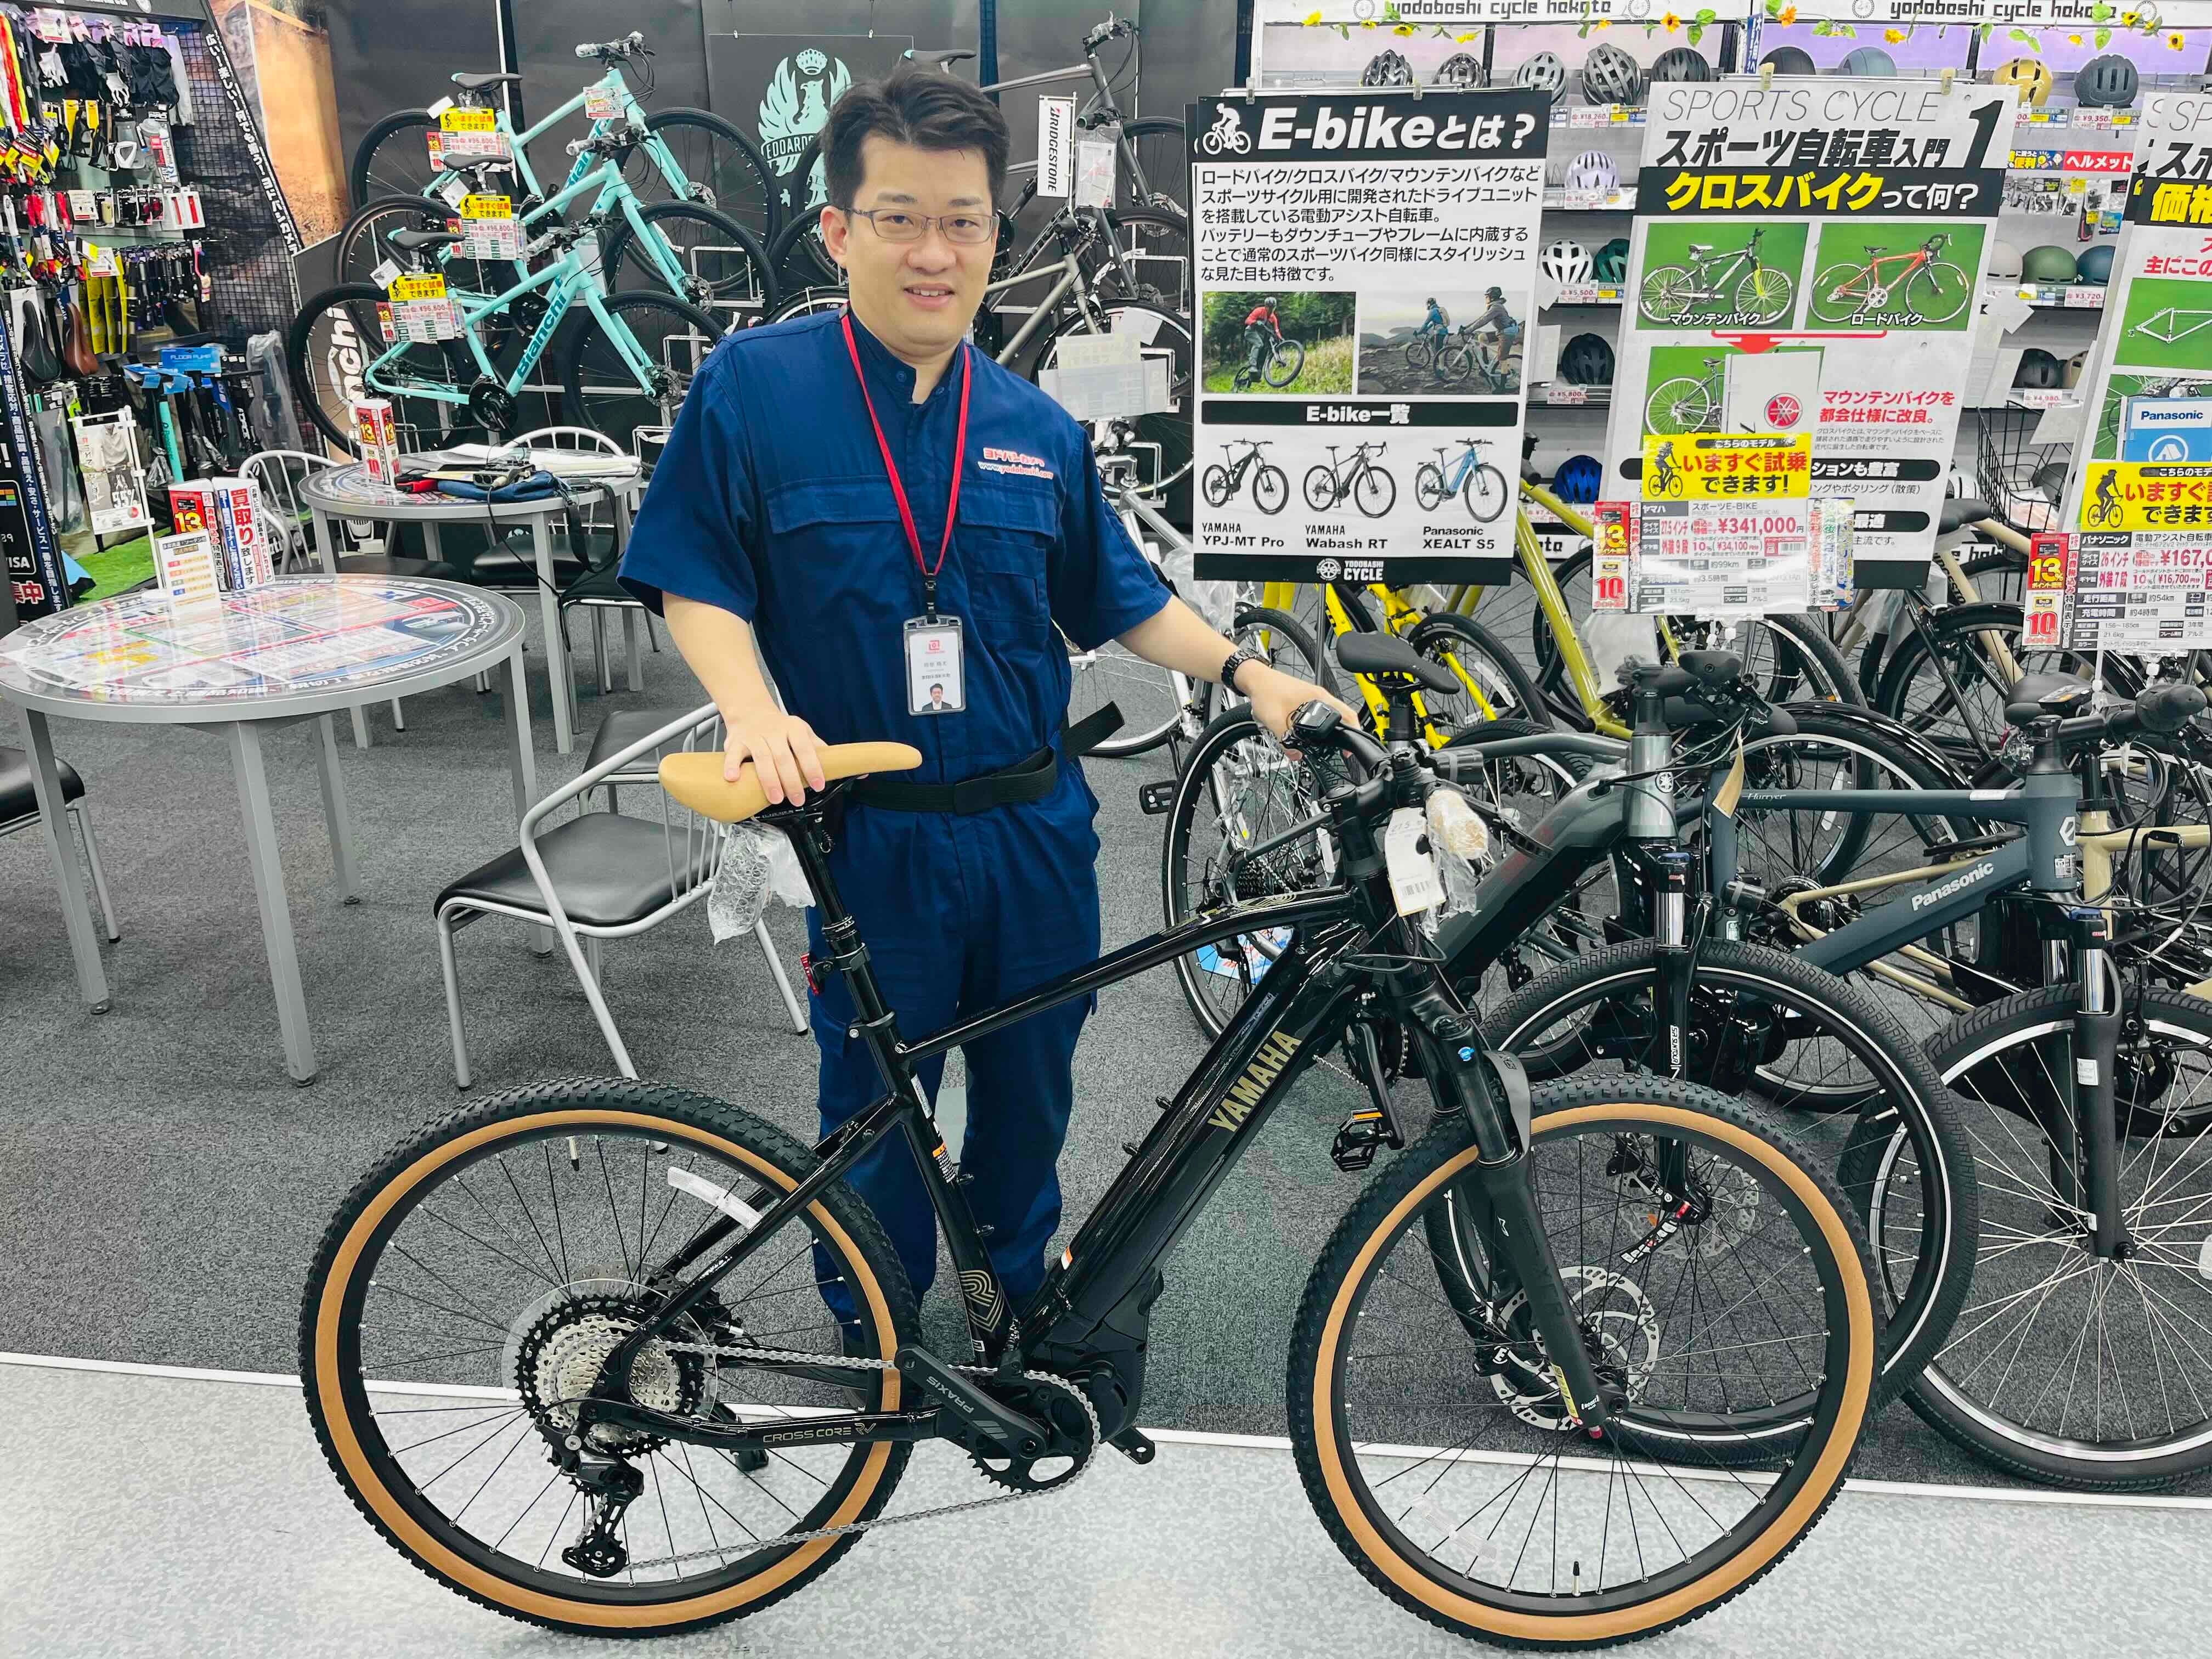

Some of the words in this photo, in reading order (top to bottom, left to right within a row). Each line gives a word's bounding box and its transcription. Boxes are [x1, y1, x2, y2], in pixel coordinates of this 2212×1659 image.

[1490, 1, 1537, 19] cycle
[1891, 0, 1984, 21] yodobashi
[1993, 3, 2042, 23] cycle
[1662, 89, 1811, 122] SPORTS
[1822, 90, 1942, 122] CYCLE
[1257, 105, 1536, 150] E-bikeとは?
[1655, 126, 1951, 167] スポーツ自転車入門
[1961, 99, 2005, 169] 1
[765, 134, 815, 160] EDOARD
[1047, 105, 1062, 193] BRIDGESTONE
[2066, 154, 2134, 171] ヘルメット
[1201, 165, 1540, 184] ロードバイク/クロスバイク/マウンテンバイクなど
[1201, 185, 1538, 204] スポーツサイクル用に開発されたドライブユニット
[1664, 171, 1979, 211] クロスバイクって何?
[1201, 207, 1440, 223] を搭載している電動アシスト自転車。
[1201, 225, 1528, 243] バッテリーもダウンチューブやフレームに内蔵する
[1201, 246, 1526, 263] ことで通常のスポーツバイク同様にスタイリッシュ
[1200, 266, 1336, 282] な見た目も特徴です。
[1669, 312, 1762, 326] マウンテンバイク
[1850, 312, 1925, 326] ロードバイク
[516, 293, 568, 379] Bianchi
[1823, 391, 1955, 406] マウンテンバイクを
[1306, 404, 1410, 425] E-bike一覧
[1819, 408, 1934, 424] 都会仕様に改良。
[2140, 409, 2204, 421] Panasonic
[1682, 451, 1808, 473] いますぐ試乗
[1700, 473, 1790, 494] できます!
[1692, 503, 1758, 511] スポーツE-BIKE
[229, 487, 255, 546] 買取り
[1202, 522, 1242, 533] YAMAHA
[1305, 524, 1345, 535] YAMAHA
[1423, 525, 1483, 535] Panasonic
[1203, 535, 1256, 548] YPJ-MT
[1262, 536, 1285, 547] Pro
[1306, 538, 1363, 549] Wabash
[1368, 539, 1388, 549] RT
[1423, 539, 1471, 549] XEALT
[1476, 539, 1495, 549] S5
[1853, 535, 1896, 546] 主流です。
[2081, 534, 2129, 545] パナソニック
[1343, 568, 1384, 581] CYCLE
[1911, 860, 1994, 911] Panasonic
[1207, 1030, 1302, 1132] YAMAHA
[926, 1376, 974, 1414] PRAXIS
[763, 1430, 814, 1443] CROSS
[816, 1426, 852, 1437] CORE
